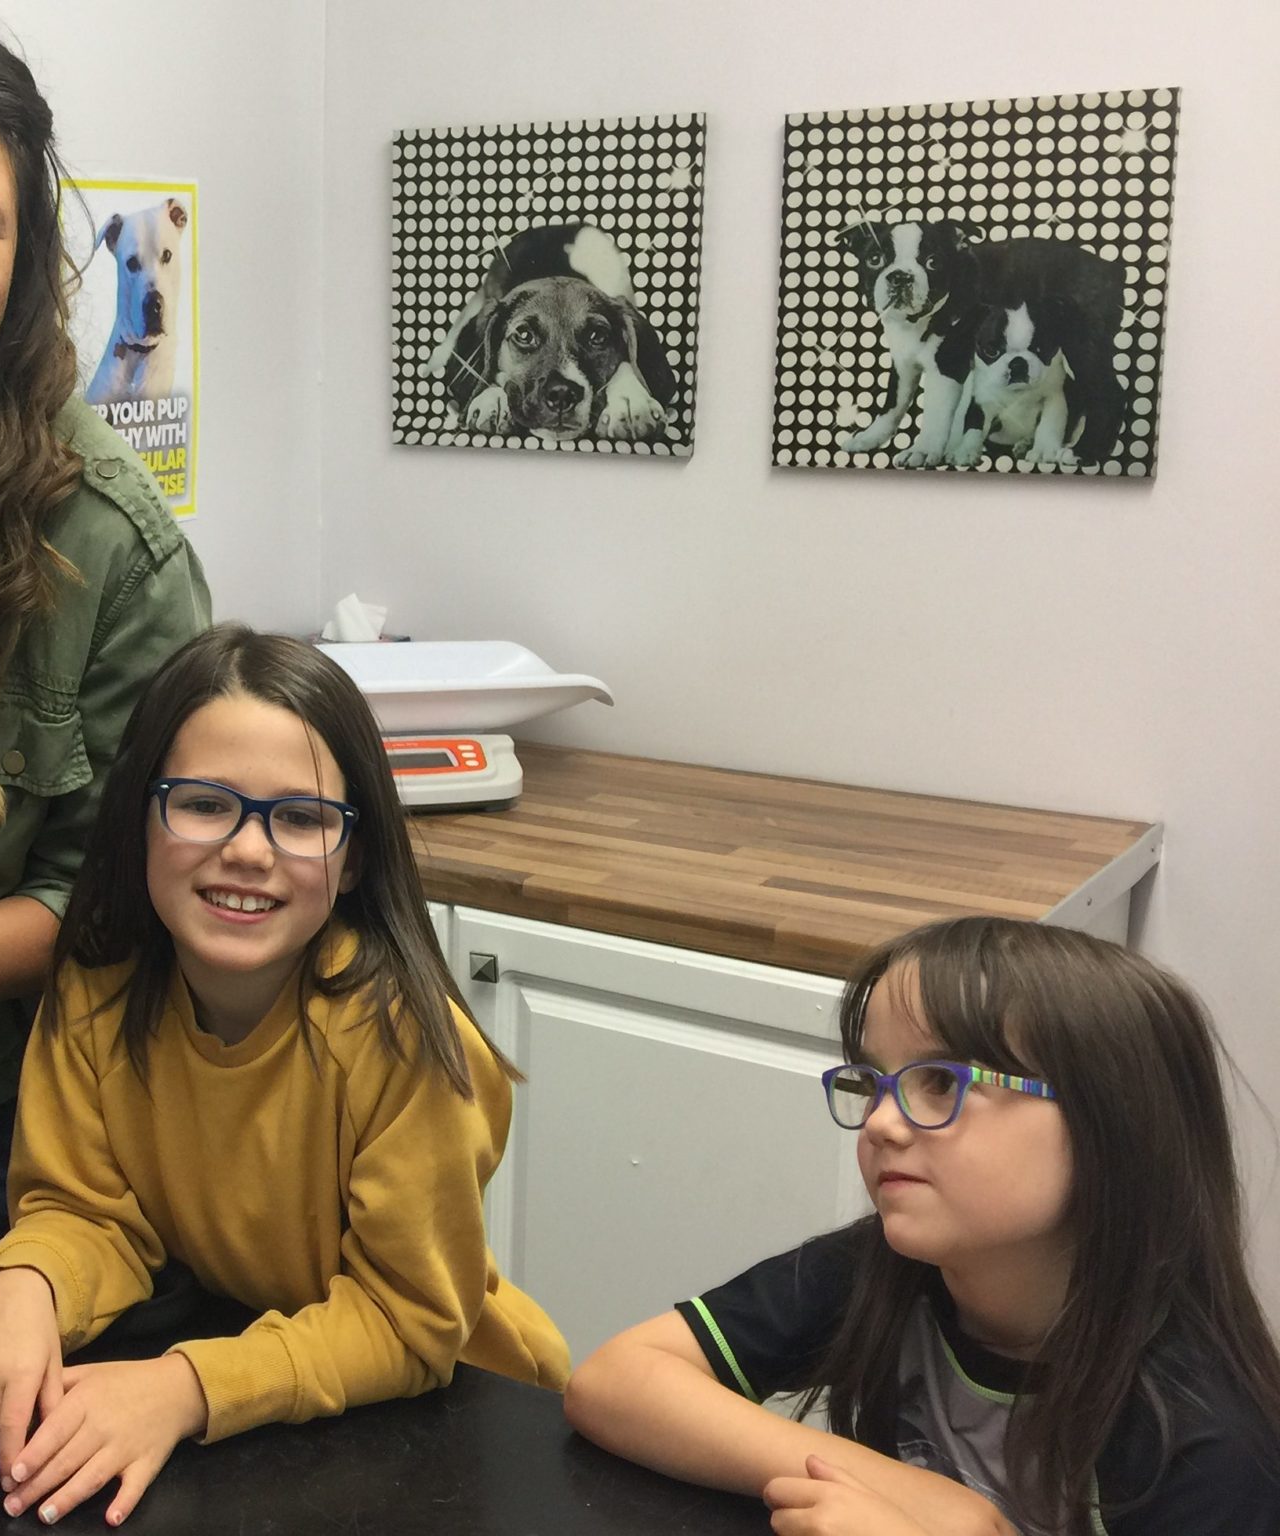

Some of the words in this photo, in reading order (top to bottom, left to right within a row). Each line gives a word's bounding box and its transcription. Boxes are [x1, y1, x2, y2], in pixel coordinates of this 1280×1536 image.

[110, 400, 155, 425] YOUR
[157, 397, 187, 420] PUP
[145, 423, 187, 448] WITH
